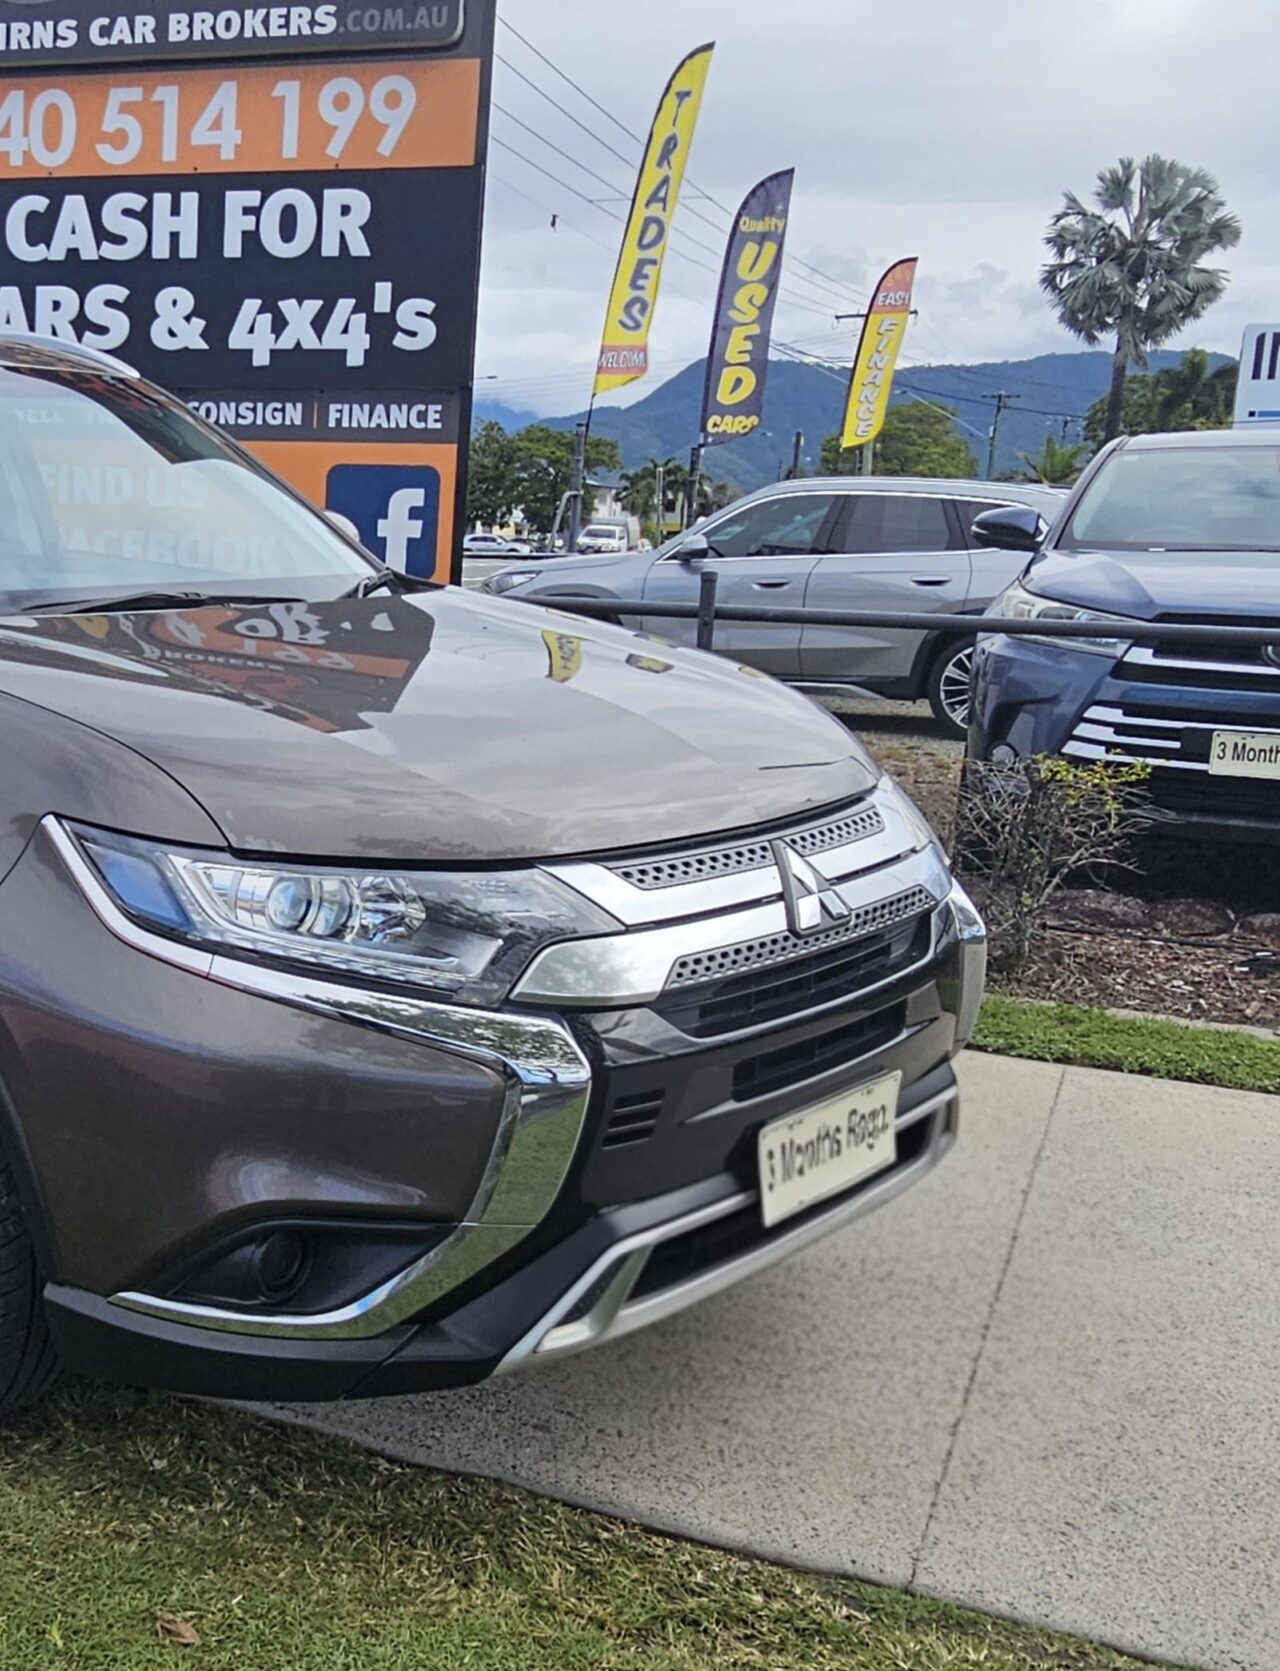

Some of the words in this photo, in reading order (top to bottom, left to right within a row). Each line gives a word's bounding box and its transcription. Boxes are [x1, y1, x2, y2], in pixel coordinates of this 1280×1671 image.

[88, 15, 157, 47] CAR
[94, 79, 242, 166] 514
[271, 73, 417, 159] 199
[5, 191, 200, 263] CASH
[222, 187, 372, 259] FOR
[617, 89, 693, 333] TRADES
[739, 216, 786, 233] Quality
[150, 287, 210, 351] &
[715, 240, 778, 406] USED
[855, 317, 900, 438] FINANCE
[327, 403, 442, 429] FINANCE
[706, 414, 760, 434] CARS
[1217, 741, 1227, 760] 3
[780, 1123, 842, 1183] Months
